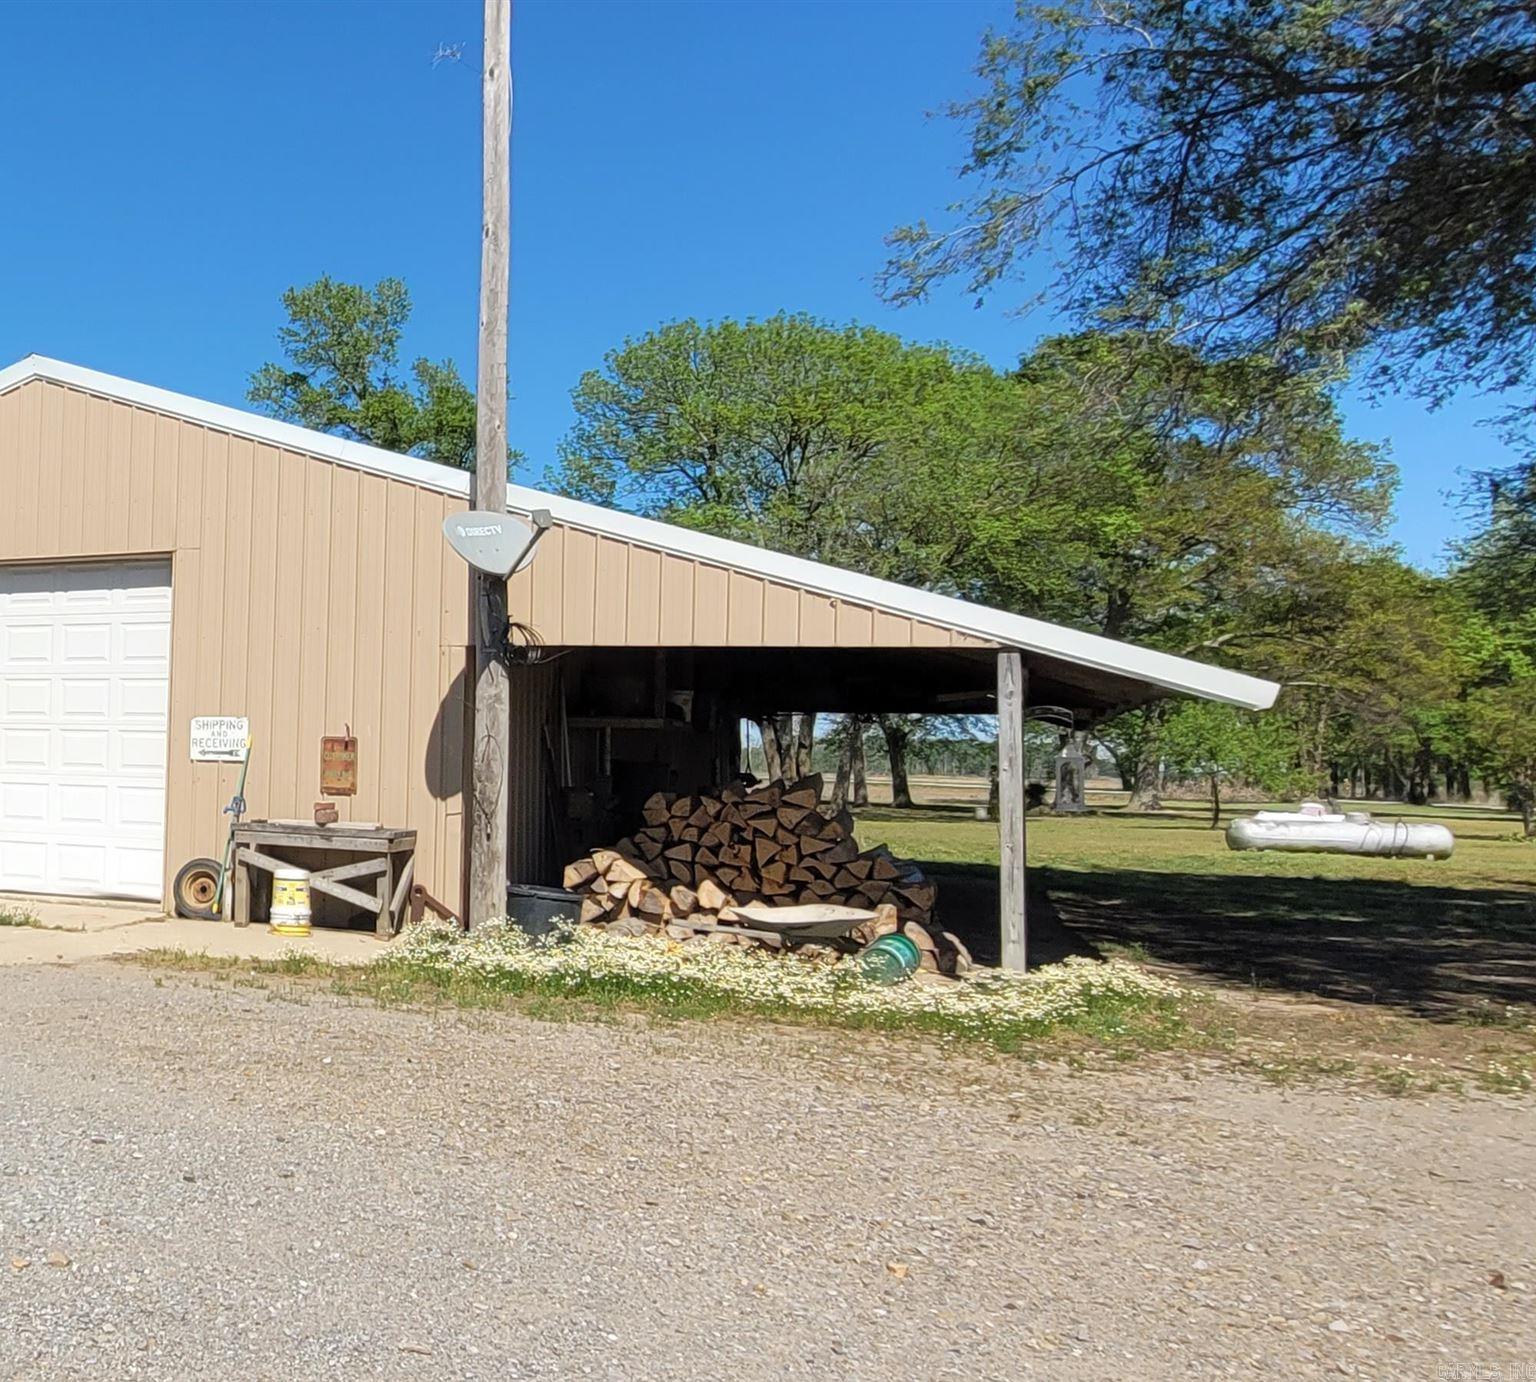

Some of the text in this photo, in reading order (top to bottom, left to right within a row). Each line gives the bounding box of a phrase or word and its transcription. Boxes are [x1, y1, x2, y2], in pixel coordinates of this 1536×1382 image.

[465, 524, 502, 536] DIRECTV
[195, 720, 244, 730] SHIPPING
[192, 738, 246, 748] RECEIVING
